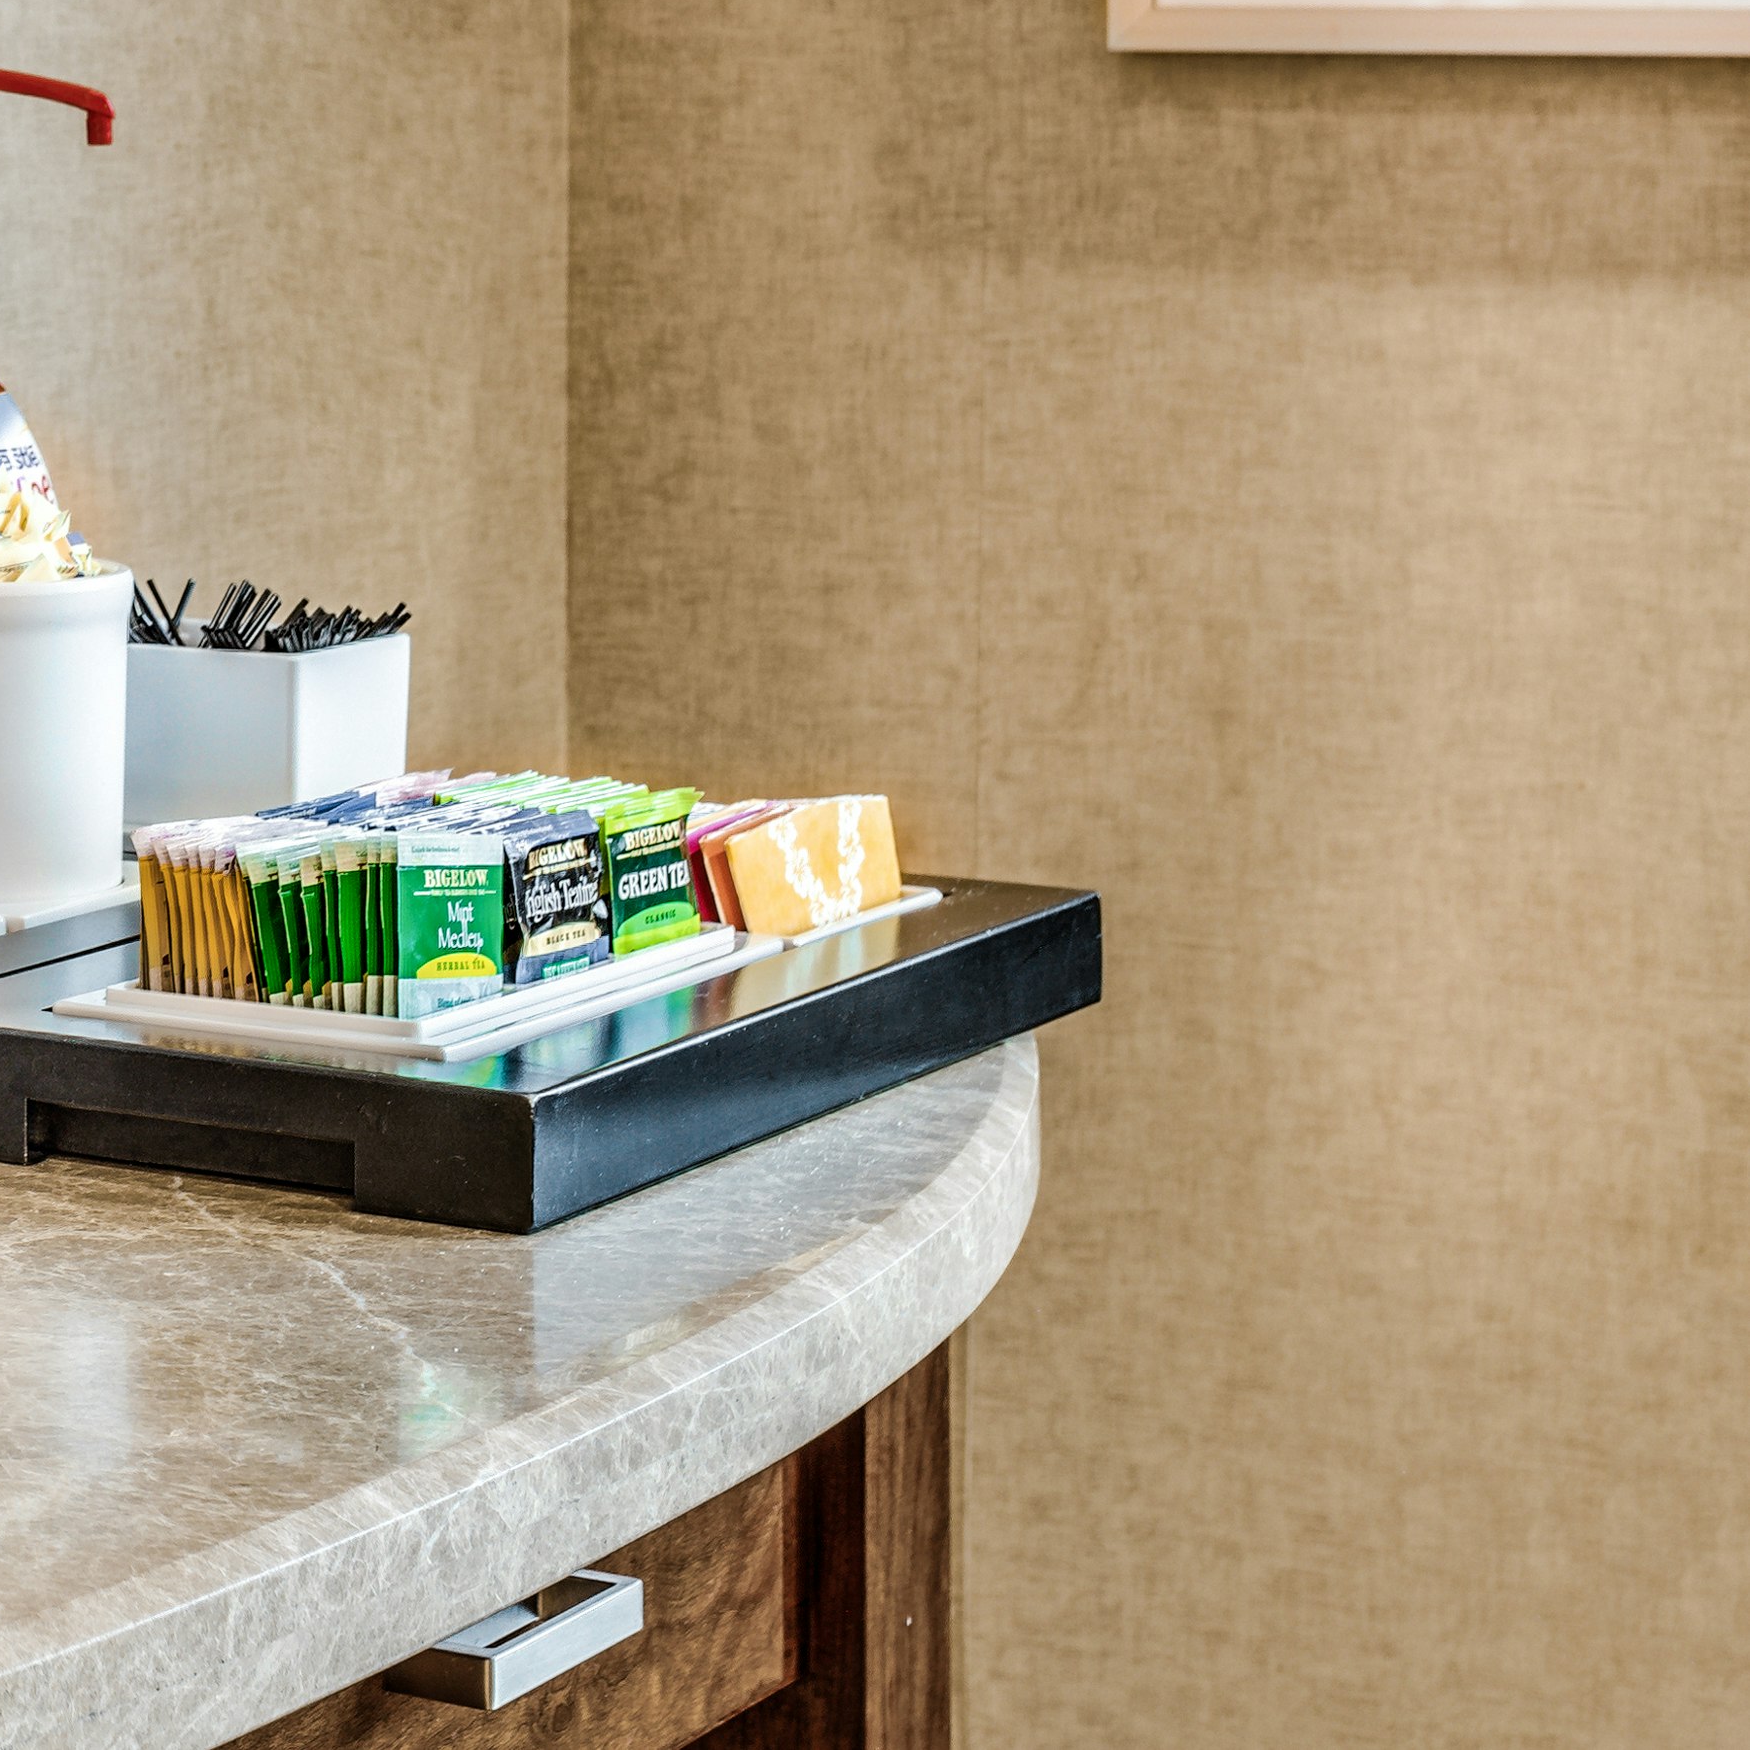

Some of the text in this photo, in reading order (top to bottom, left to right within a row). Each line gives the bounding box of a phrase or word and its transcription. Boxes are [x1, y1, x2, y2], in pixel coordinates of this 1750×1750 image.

[423, 869, 488, 888] BIGELOW
[618, 865, 668, 900] GREEN
[573, 930, 586, 940] TEA
[437, 959, 485, 971] HERBAL TEA
